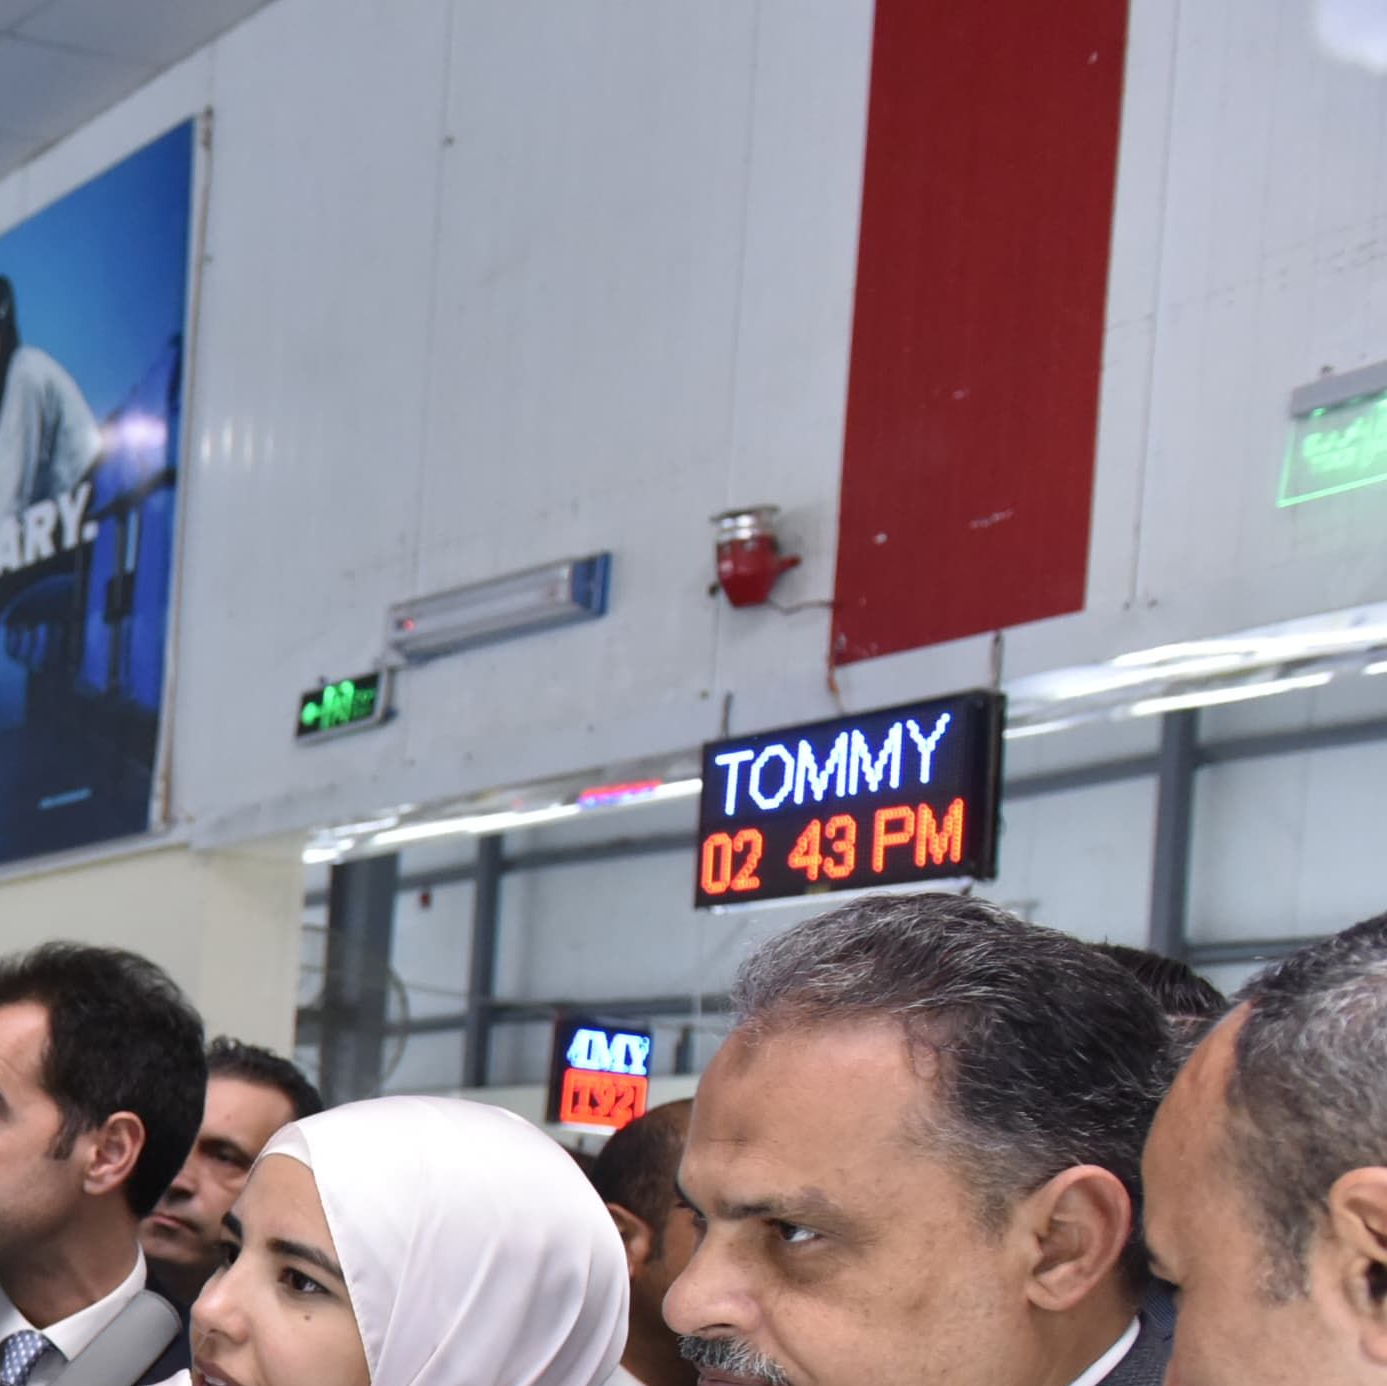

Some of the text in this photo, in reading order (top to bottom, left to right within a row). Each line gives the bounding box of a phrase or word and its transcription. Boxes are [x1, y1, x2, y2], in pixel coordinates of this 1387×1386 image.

[714, 712, 951, 816] TOMMY
[700, 797, 965, 895] 02 43 PM
